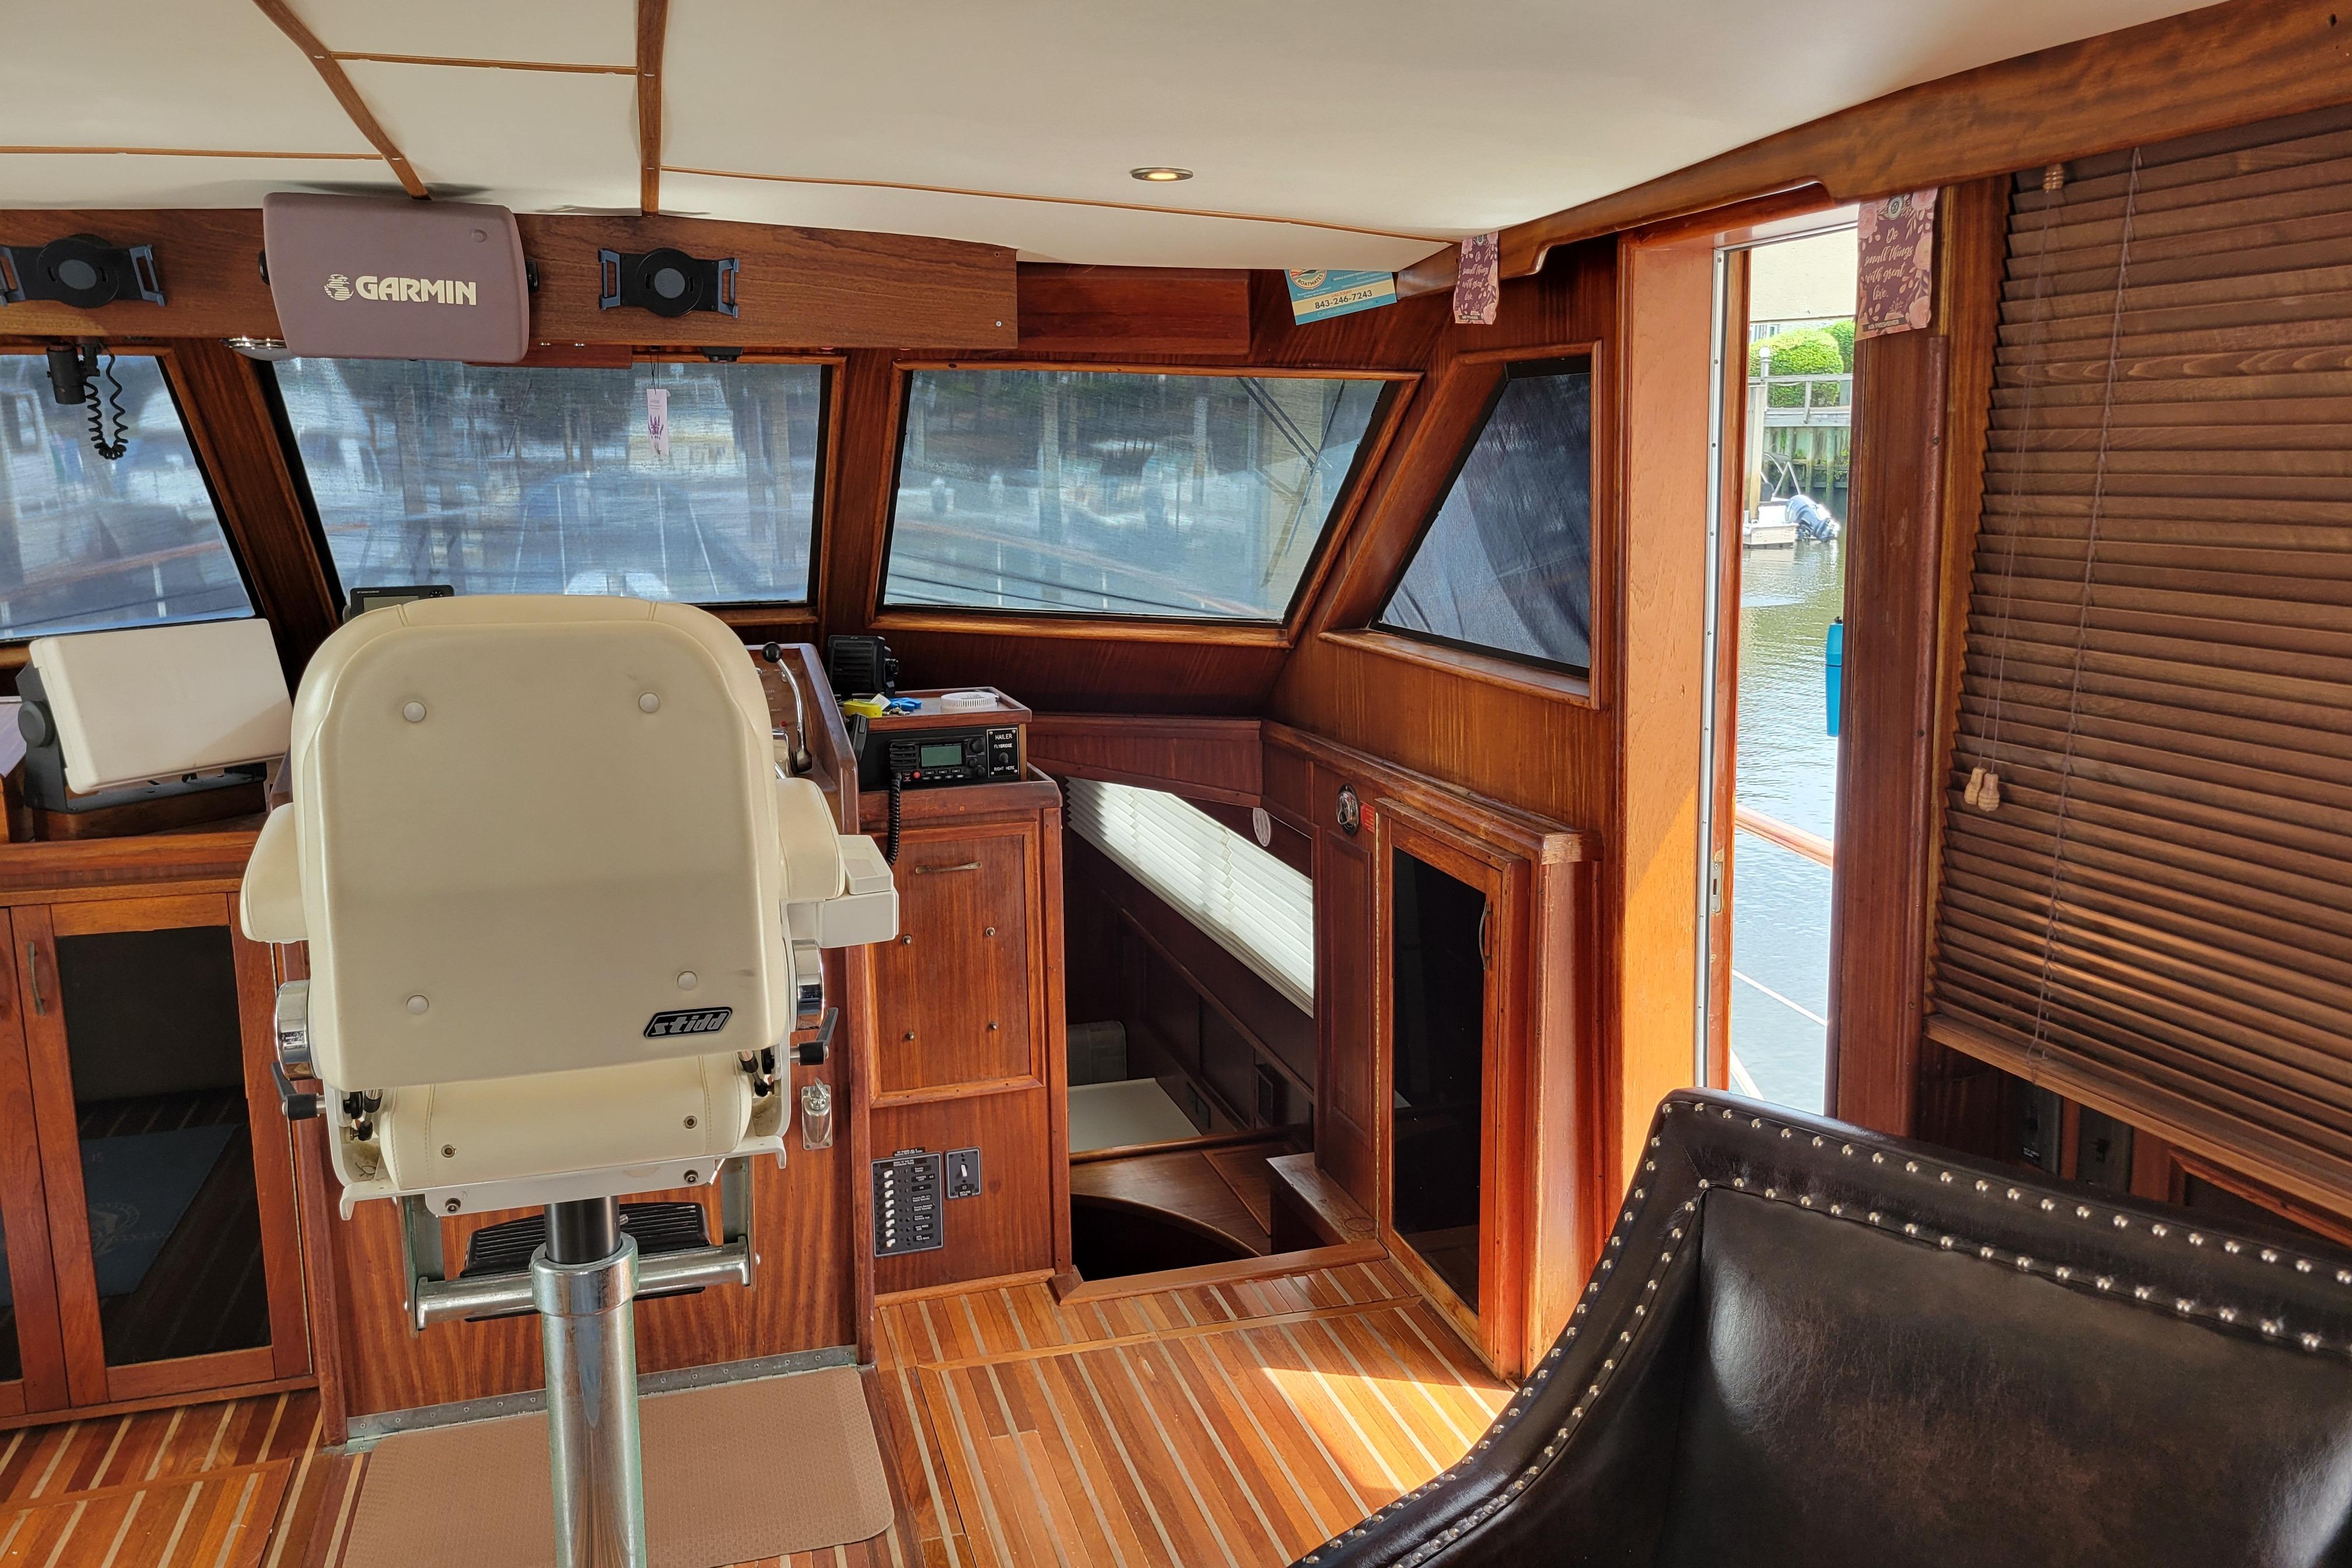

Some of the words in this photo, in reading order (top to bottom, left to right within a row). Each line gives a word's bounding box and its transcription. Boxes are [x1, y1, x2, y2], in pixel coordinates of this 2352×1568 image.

[1886, 227, 1898, 244] Do
[1864, 246, 1888, 267] small
[1888, 244, 1913, 262] things
[1297, 273, 1324, 287] BOATMATES
[1865, 267, 1882, 284] with
[1883, 261, 1907, 284] great
[355, 275, 477, 306] GARMIN
[1314, 290, 1373, 309] 843-246-7243
[1873, 284, 1889, 301] love.
[651, 1013, 727, 1035] stidd
